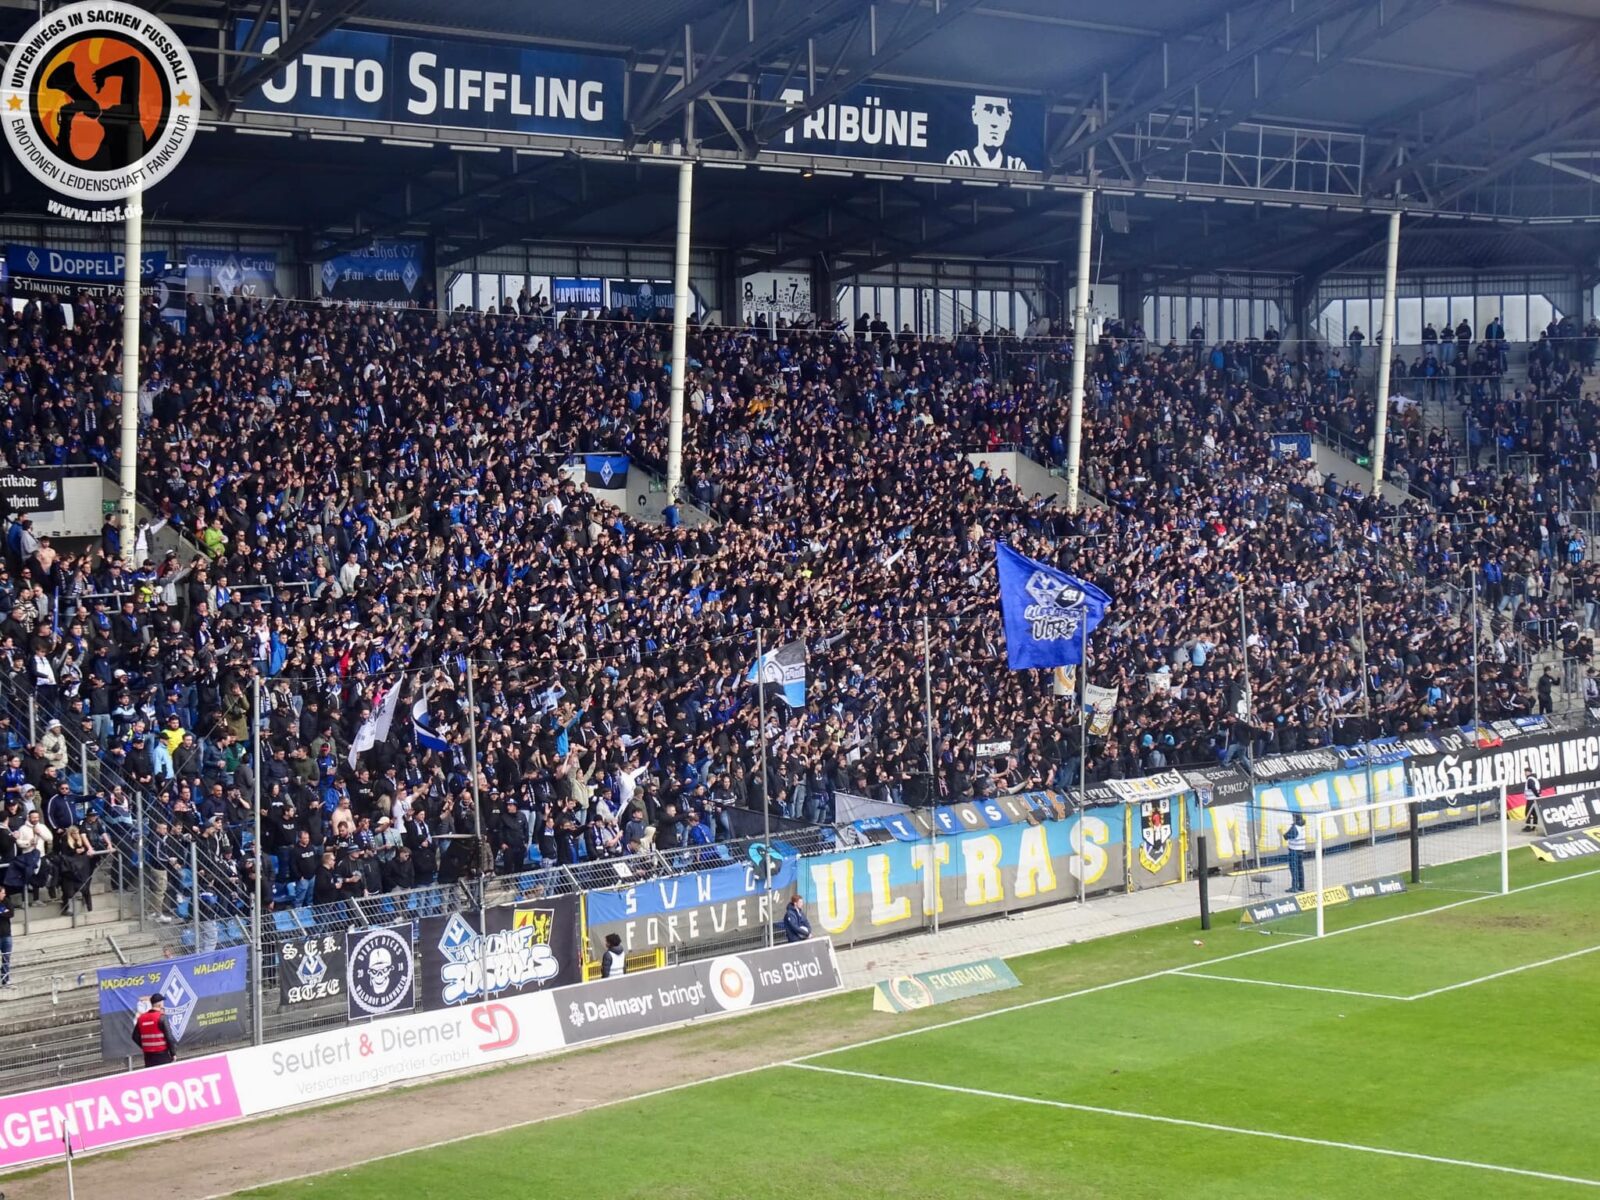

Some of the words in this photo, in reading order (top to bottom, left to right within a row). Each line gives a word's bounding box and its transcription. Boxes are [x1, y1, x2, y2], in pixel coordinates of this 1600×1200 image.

[407, 51, 604, 122] SIFFLING
[241, 258, 275, 272] Crew
[342, 268, 364, 282] Fan
[375, 268, 400, 281] Club
[1562, 736, 1600, 775] MEC
[1542, 836, 1600, 858] bwin
[811, 814, 1109, 935] ULTRAS
[1298, 888, 1349, 909] SPORTETTEN
[1352, 884, 1375, 897] bwin
[1378, 880, 1402, 892] bwin
[193, 959, 237, 976] WALDHOF
[928, 964, 997, 990] EICHBAUM
[287, 978, 340, 1004] ATZE
[584, 994, 654, 1023] Dallmayr
[658, 981, 706, 1008] bringt
[758, 967, 782, 987] ins
[783, 957, 823, 983] Büro!
[272, 1040, 350, 1077] Seufert
[359, 1033, 374, 1057] &
[381, 1020, 463, 1052] Diemer
[121, 1073, 222, 1124] SPORT
